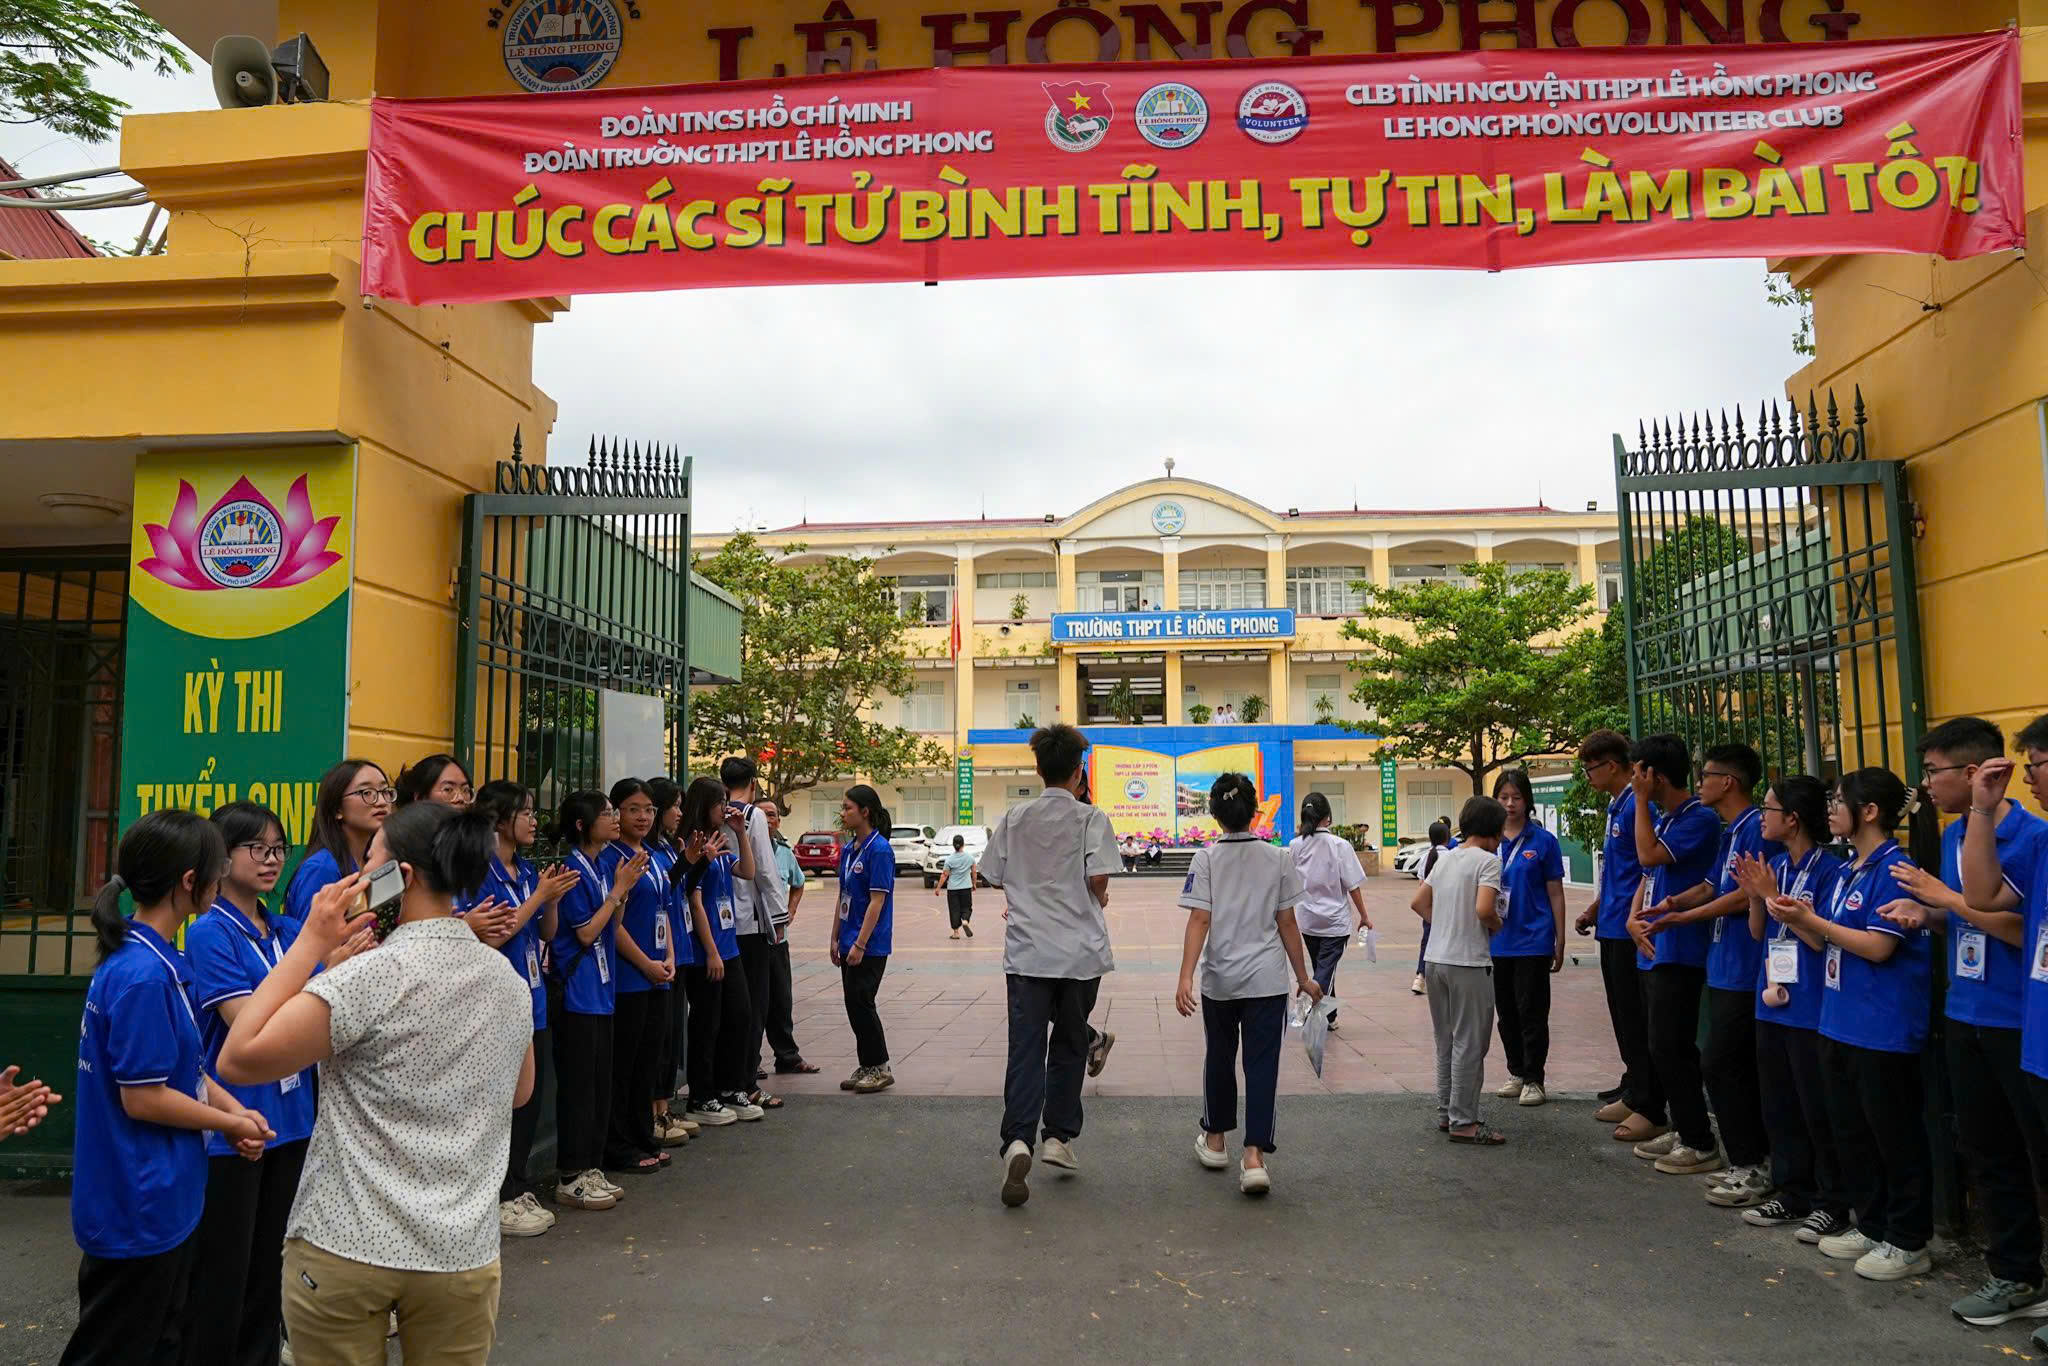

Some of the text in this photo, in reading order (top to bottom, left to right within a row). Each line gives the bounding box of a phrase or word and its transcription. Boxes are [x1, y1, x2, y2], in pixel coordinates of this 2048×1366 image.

[509, 47, 525, 57] LÊ
[570, 42, 614, 53] PHONG
[581, 59, 610, 87] PHÒNG
[1346, 61, 1877, 108] CLB TÌNH NGUYỆN THPT LÊ HỒNG PHONG
[600, 94, 912, 138] ĐOÀN TNCS HỒ CHÍ MINH
[1245, 117, 1301, 128] VOLUNTEER
[1384, 105, 1844, 138] LE HONG PHONG VOLUNTEER CLUB
[523, 123, 994, 173] ĐOÀN TRƯỜNG THPT LÊ HỒNG PHONG
[408, 183, 585, 263] CHÚC
[592, 176, 717, 254] CÁC
[724, 177, 793, 248] SĨ
[795, 170, 895, 245] TỬ
[899, 164, 1076, 242] BÌNH
[1087, 163, 1281, 240] TĨNH,
[1289, 169, 1392, 246] TỰ
[1395, 174, 1535, 236] TIN,
[1543, 146, 1692, 222] LÀM
[1702, 140, 1827, 219] BÀI
[219, 504, 242, 516] TRUNG
[245, 546, 277, 555] PHONG
[1066, 611, 1279, 638] TRƯỜNG THPT LÊ HỒNG PHONG
[183, 657, 284, 734] KỲ THI
